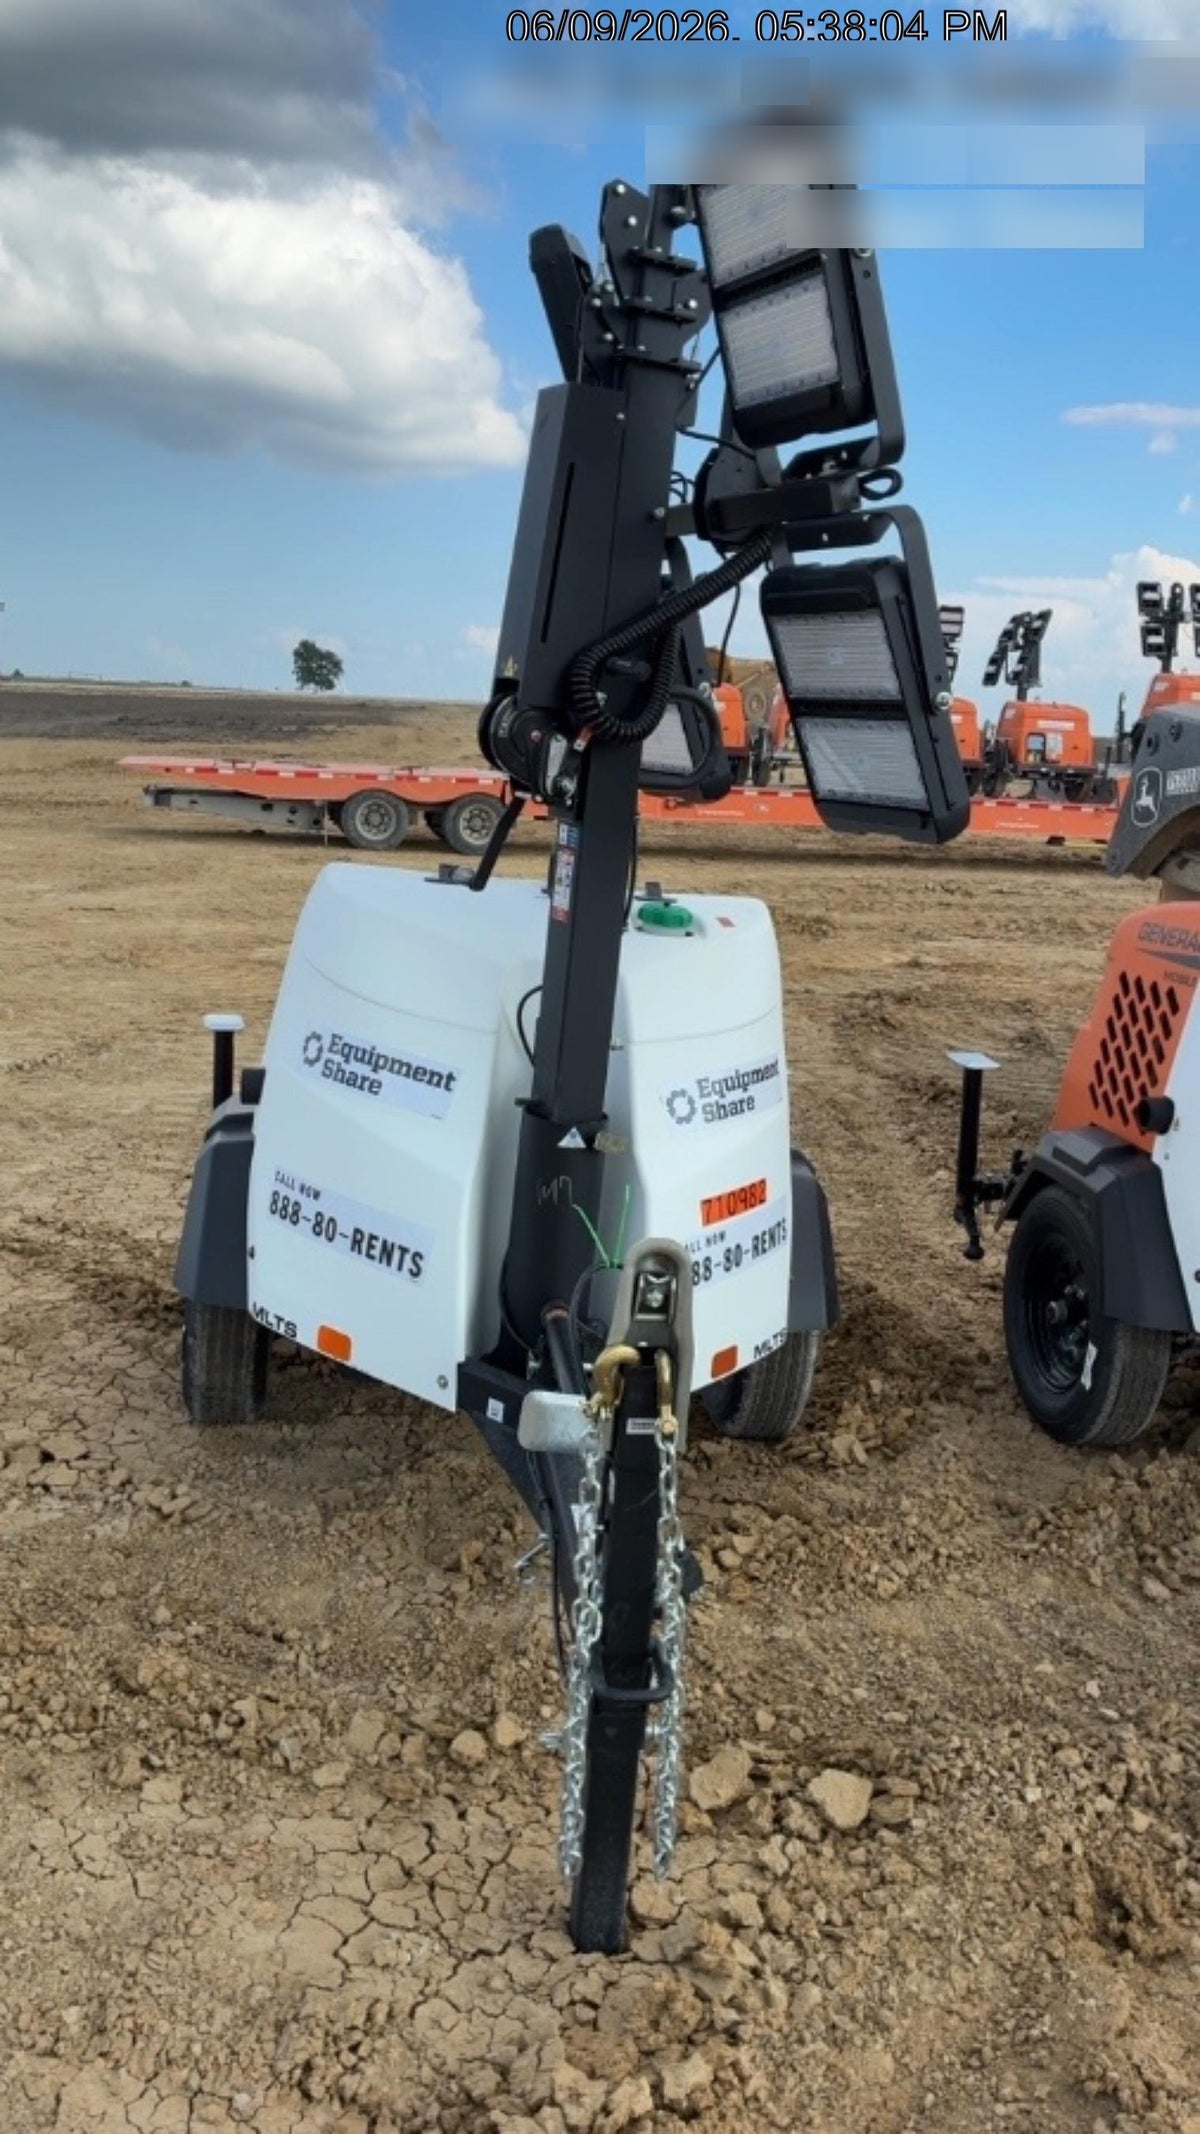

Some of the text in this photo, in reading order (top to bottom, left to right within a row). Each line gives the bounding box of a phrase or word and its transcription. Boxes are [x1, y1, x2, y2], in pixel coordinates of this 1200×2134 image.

[321, 1058, 383, 1096] Share
[327, 1033, 457, 1092] Equipment
[696, 1059, 779, 1099] Equipment
[701, 1094, 755, 1124] Share
[274, 1170, 321, 1201] CALL NOW
[701, 1178, 767, 1226] 710982
[269, 1189, 424, 1279] 888-80-RENTS
[691, 1217, 787, 1286] 88-80-RENTS
[253, 1301, 297, 1338] MLTS
